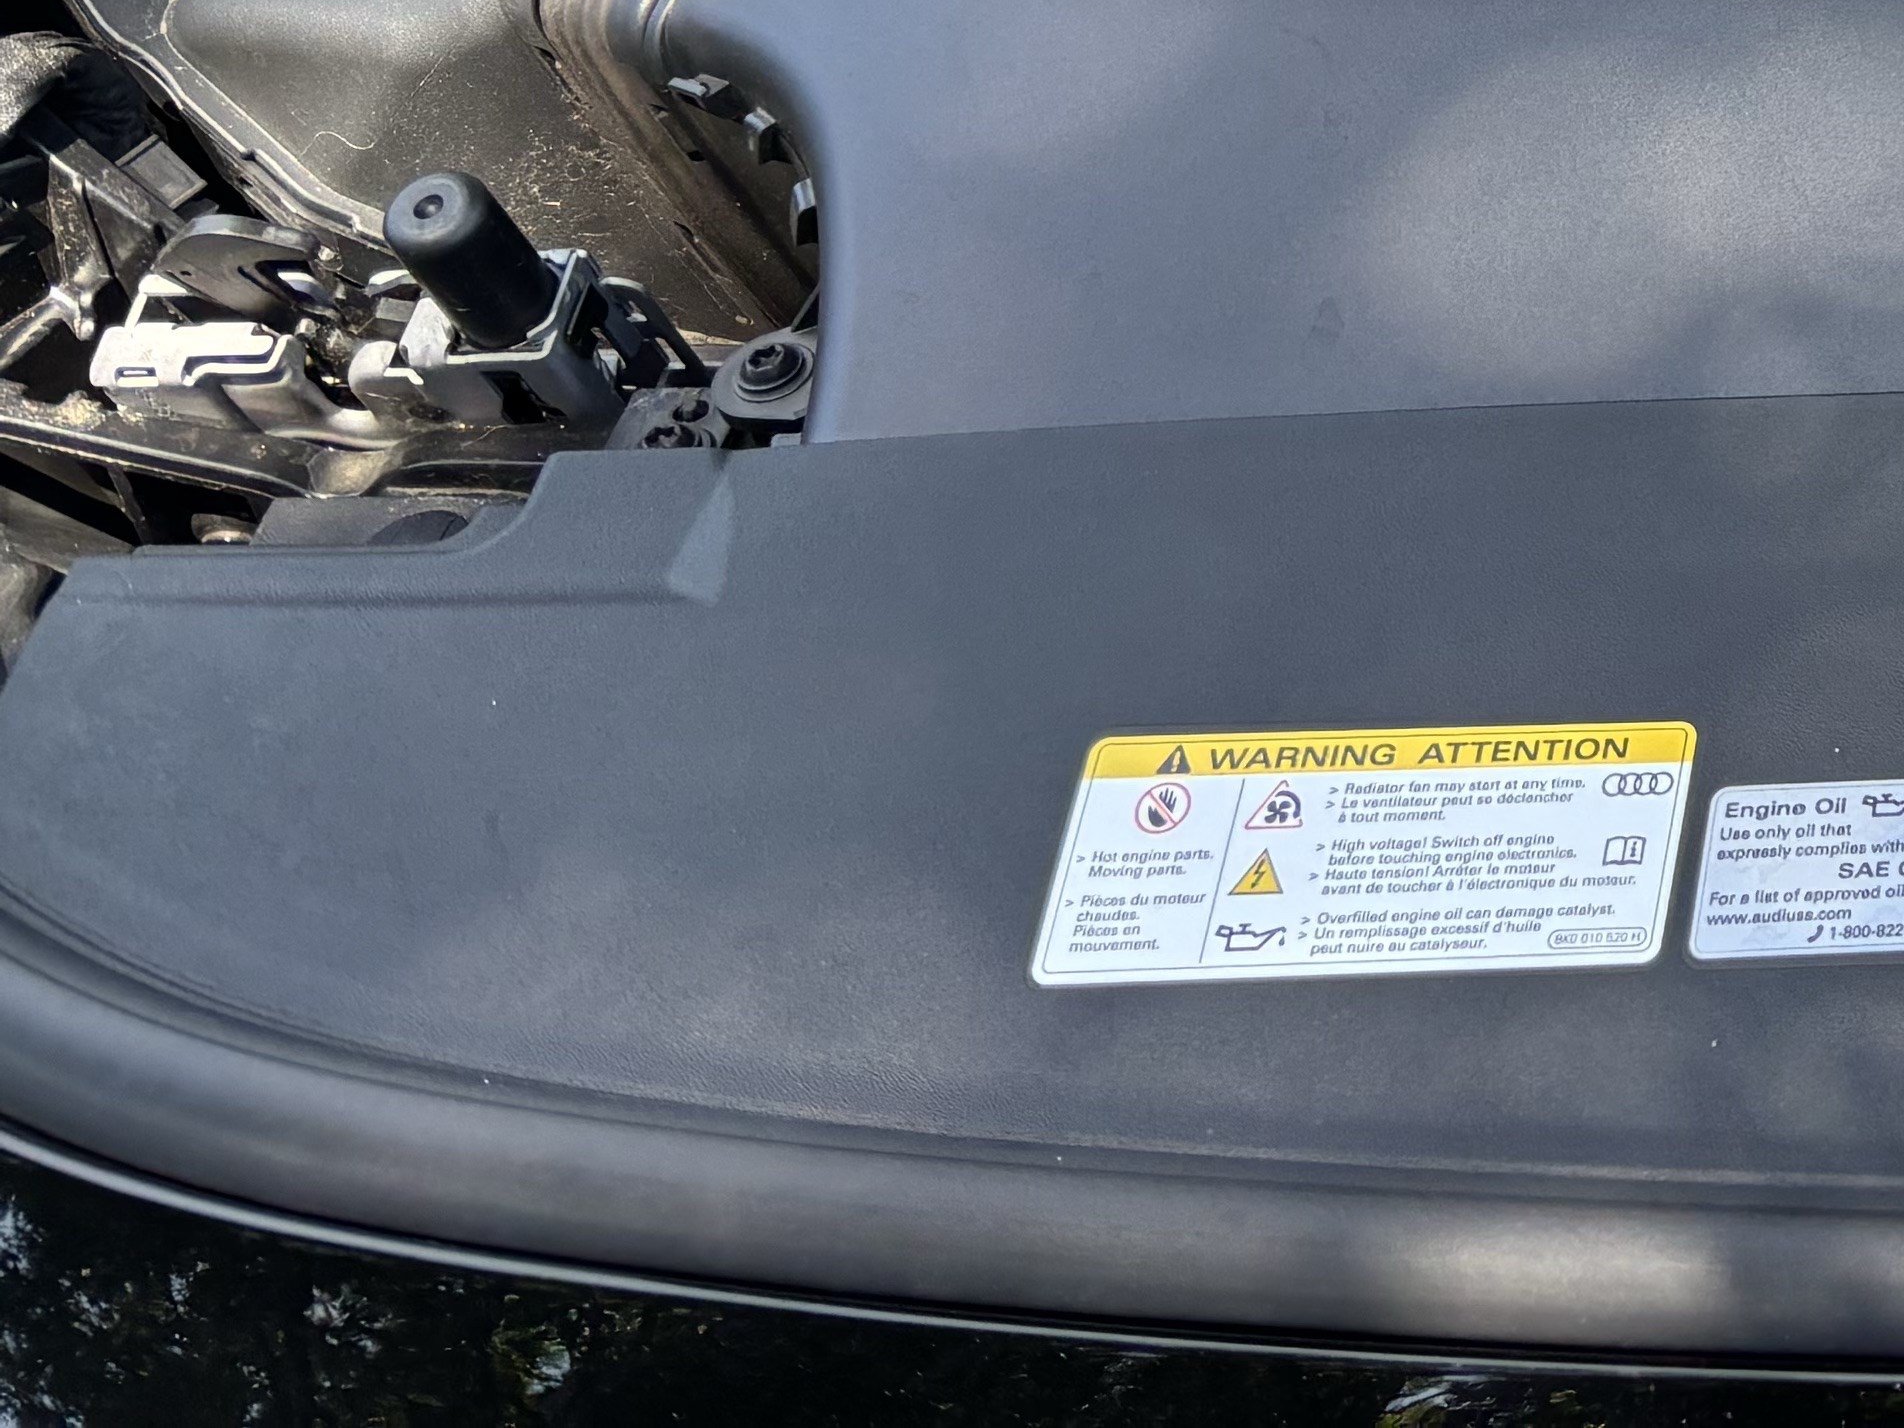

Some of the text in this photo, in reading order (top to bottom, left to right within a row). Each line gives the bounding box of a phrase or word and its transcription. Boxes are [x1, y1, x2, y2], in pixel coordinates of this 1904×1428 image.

[1211, 737, 1629, 770] WARNING ATTENTION
[1345, 777, 1585, 795] Radiator fan may start at any time.
[1342, 792, 1573, 809] Le ventilateur peut se déclencher
[1725, 798, 1846, 821] Engine Oil
[1351, 812, 1379, 822] tout
[1383, 810, 1445, 821] moment.
[1720, 823, 1851, 841] Use only oil that
[1332, 834, 1554, 852] High voltage! Switch off engine
[1717, 840, 1904, 860] expressly complies with
[1091, 849, 1213, 864] Hot engine parts.
[1328, 846, 1576, 865] before touching engine electronics.
[1088, 865, 1187, 879] Moving parts.
[1324, 868, 1367, 880] Haute
[1371, 865, 1429, 879] tension!
[1487, 865, 1499, 874] le
[1504, 863, 1555, 875] moteur
[1838, 861, 1890, 879] SAE
[1321, 883, 1362, 895] avant
[1366, 882, 1383, 894] de
[1387, 880, 1443, 892] toucher
[1560, 876, 1577, 888] du
[1582, 876, 1636, 887] moteur.
[1080, 893, 1206, 907] Pièces du moteur
[1709, 892, 1735, 905] For
[1740, 894, 1749, 905] a
[1755, 890, 1778, 904] list
[1783, 888, 1799, 903] of
[1804, 885, 1880, 904] approved
[1077, 910, 1139, 922] chaudes.
[1317, 903, 1615, 924] Overfilled engine oil can damage catalyst.
[1707, 909, 1851, 925] www.audiusa.com
[1073, 925, 1140, 937] Pièces en
[1314, 921, 1541, 940] Un remplissage excessif d'huile
[1069, 939, 1160, 953] mouvement.
[1310, 938, 1487, 956] peut nuire au catalyseur.
